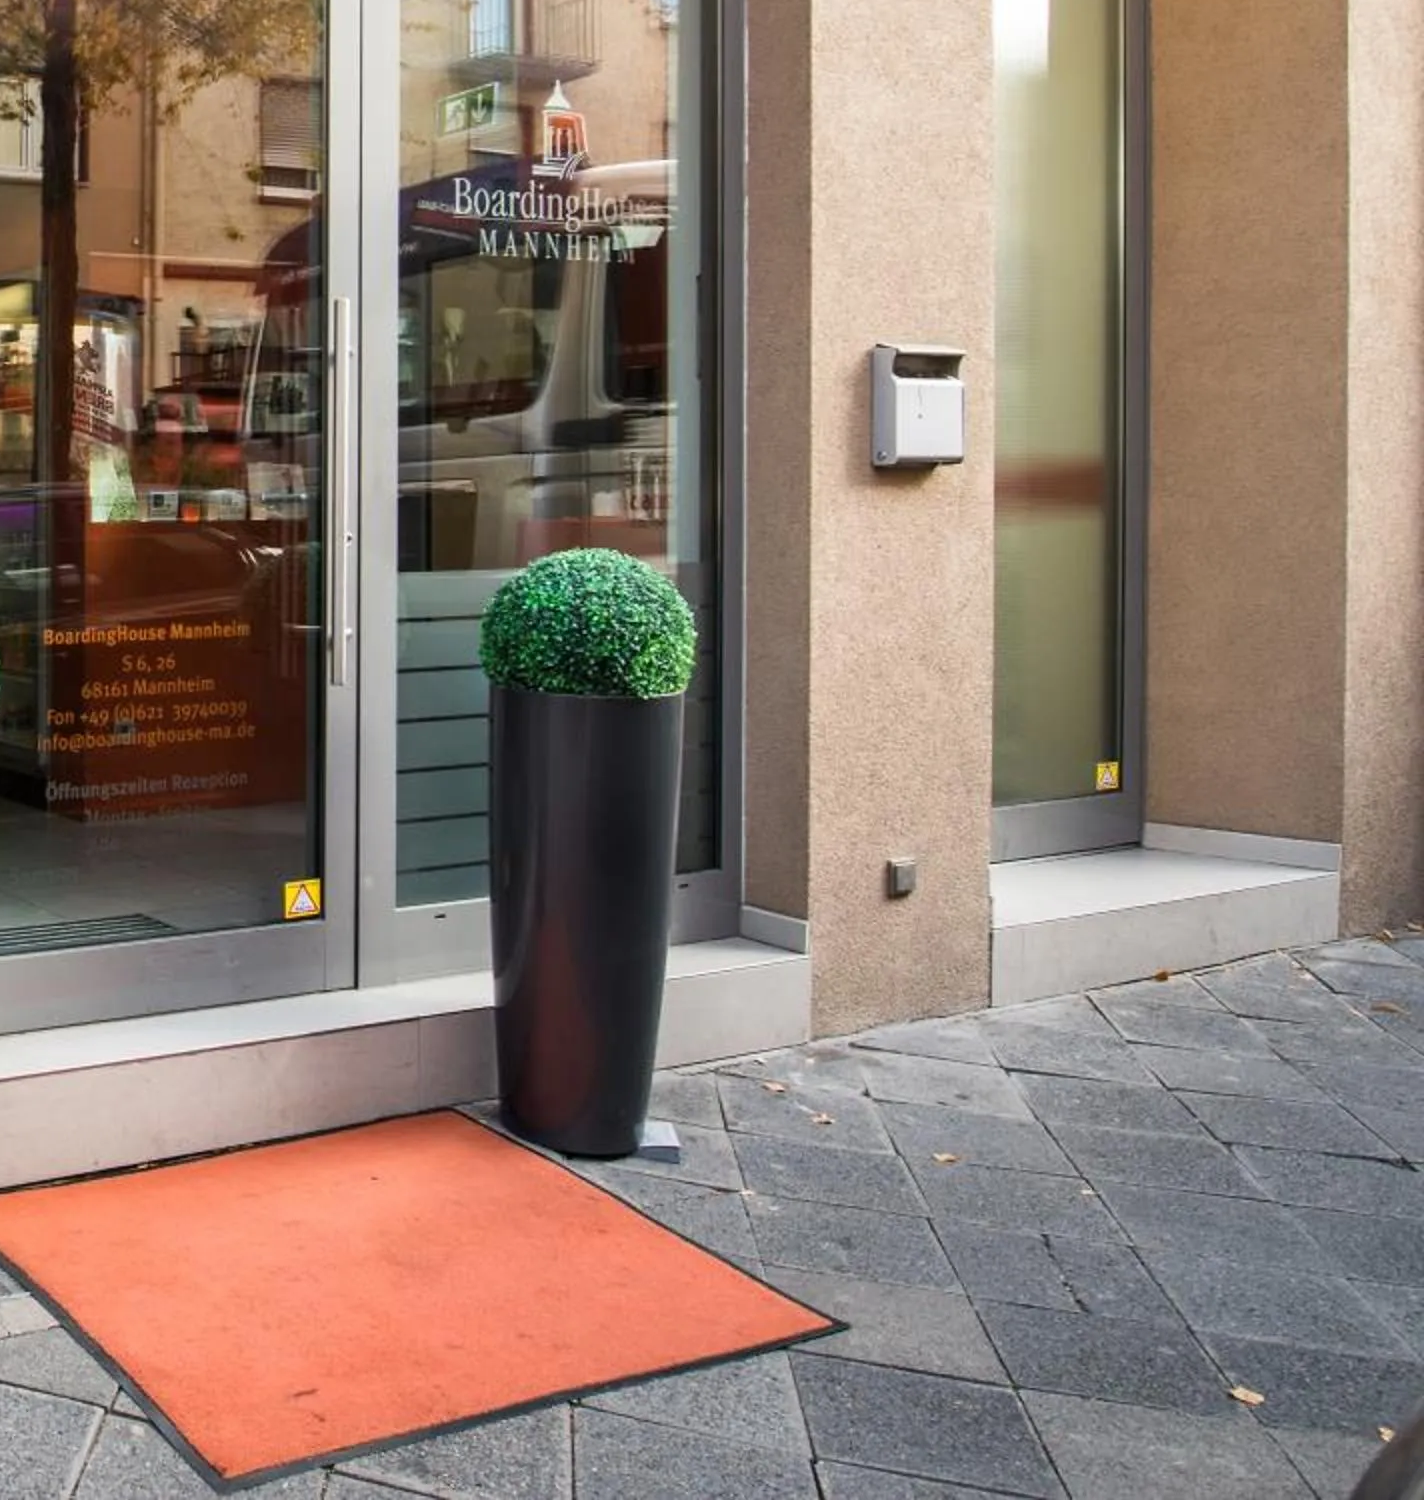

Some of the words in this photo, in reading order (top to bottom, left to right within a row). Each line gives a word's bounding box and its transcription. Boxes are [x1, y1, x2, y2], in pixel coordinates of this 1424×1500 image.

[479, 229, 636, 263] MANNHEIM
[43, 627, 166, 646] BoardingHouse
[169, 621, 252, 640] Mannheim
[157, 653, 176, 670] 26
[81, 680, 128, 699] 68161
[132, 675, 216, 696] Mannheim
[47, 708, 75, 725] Fon
